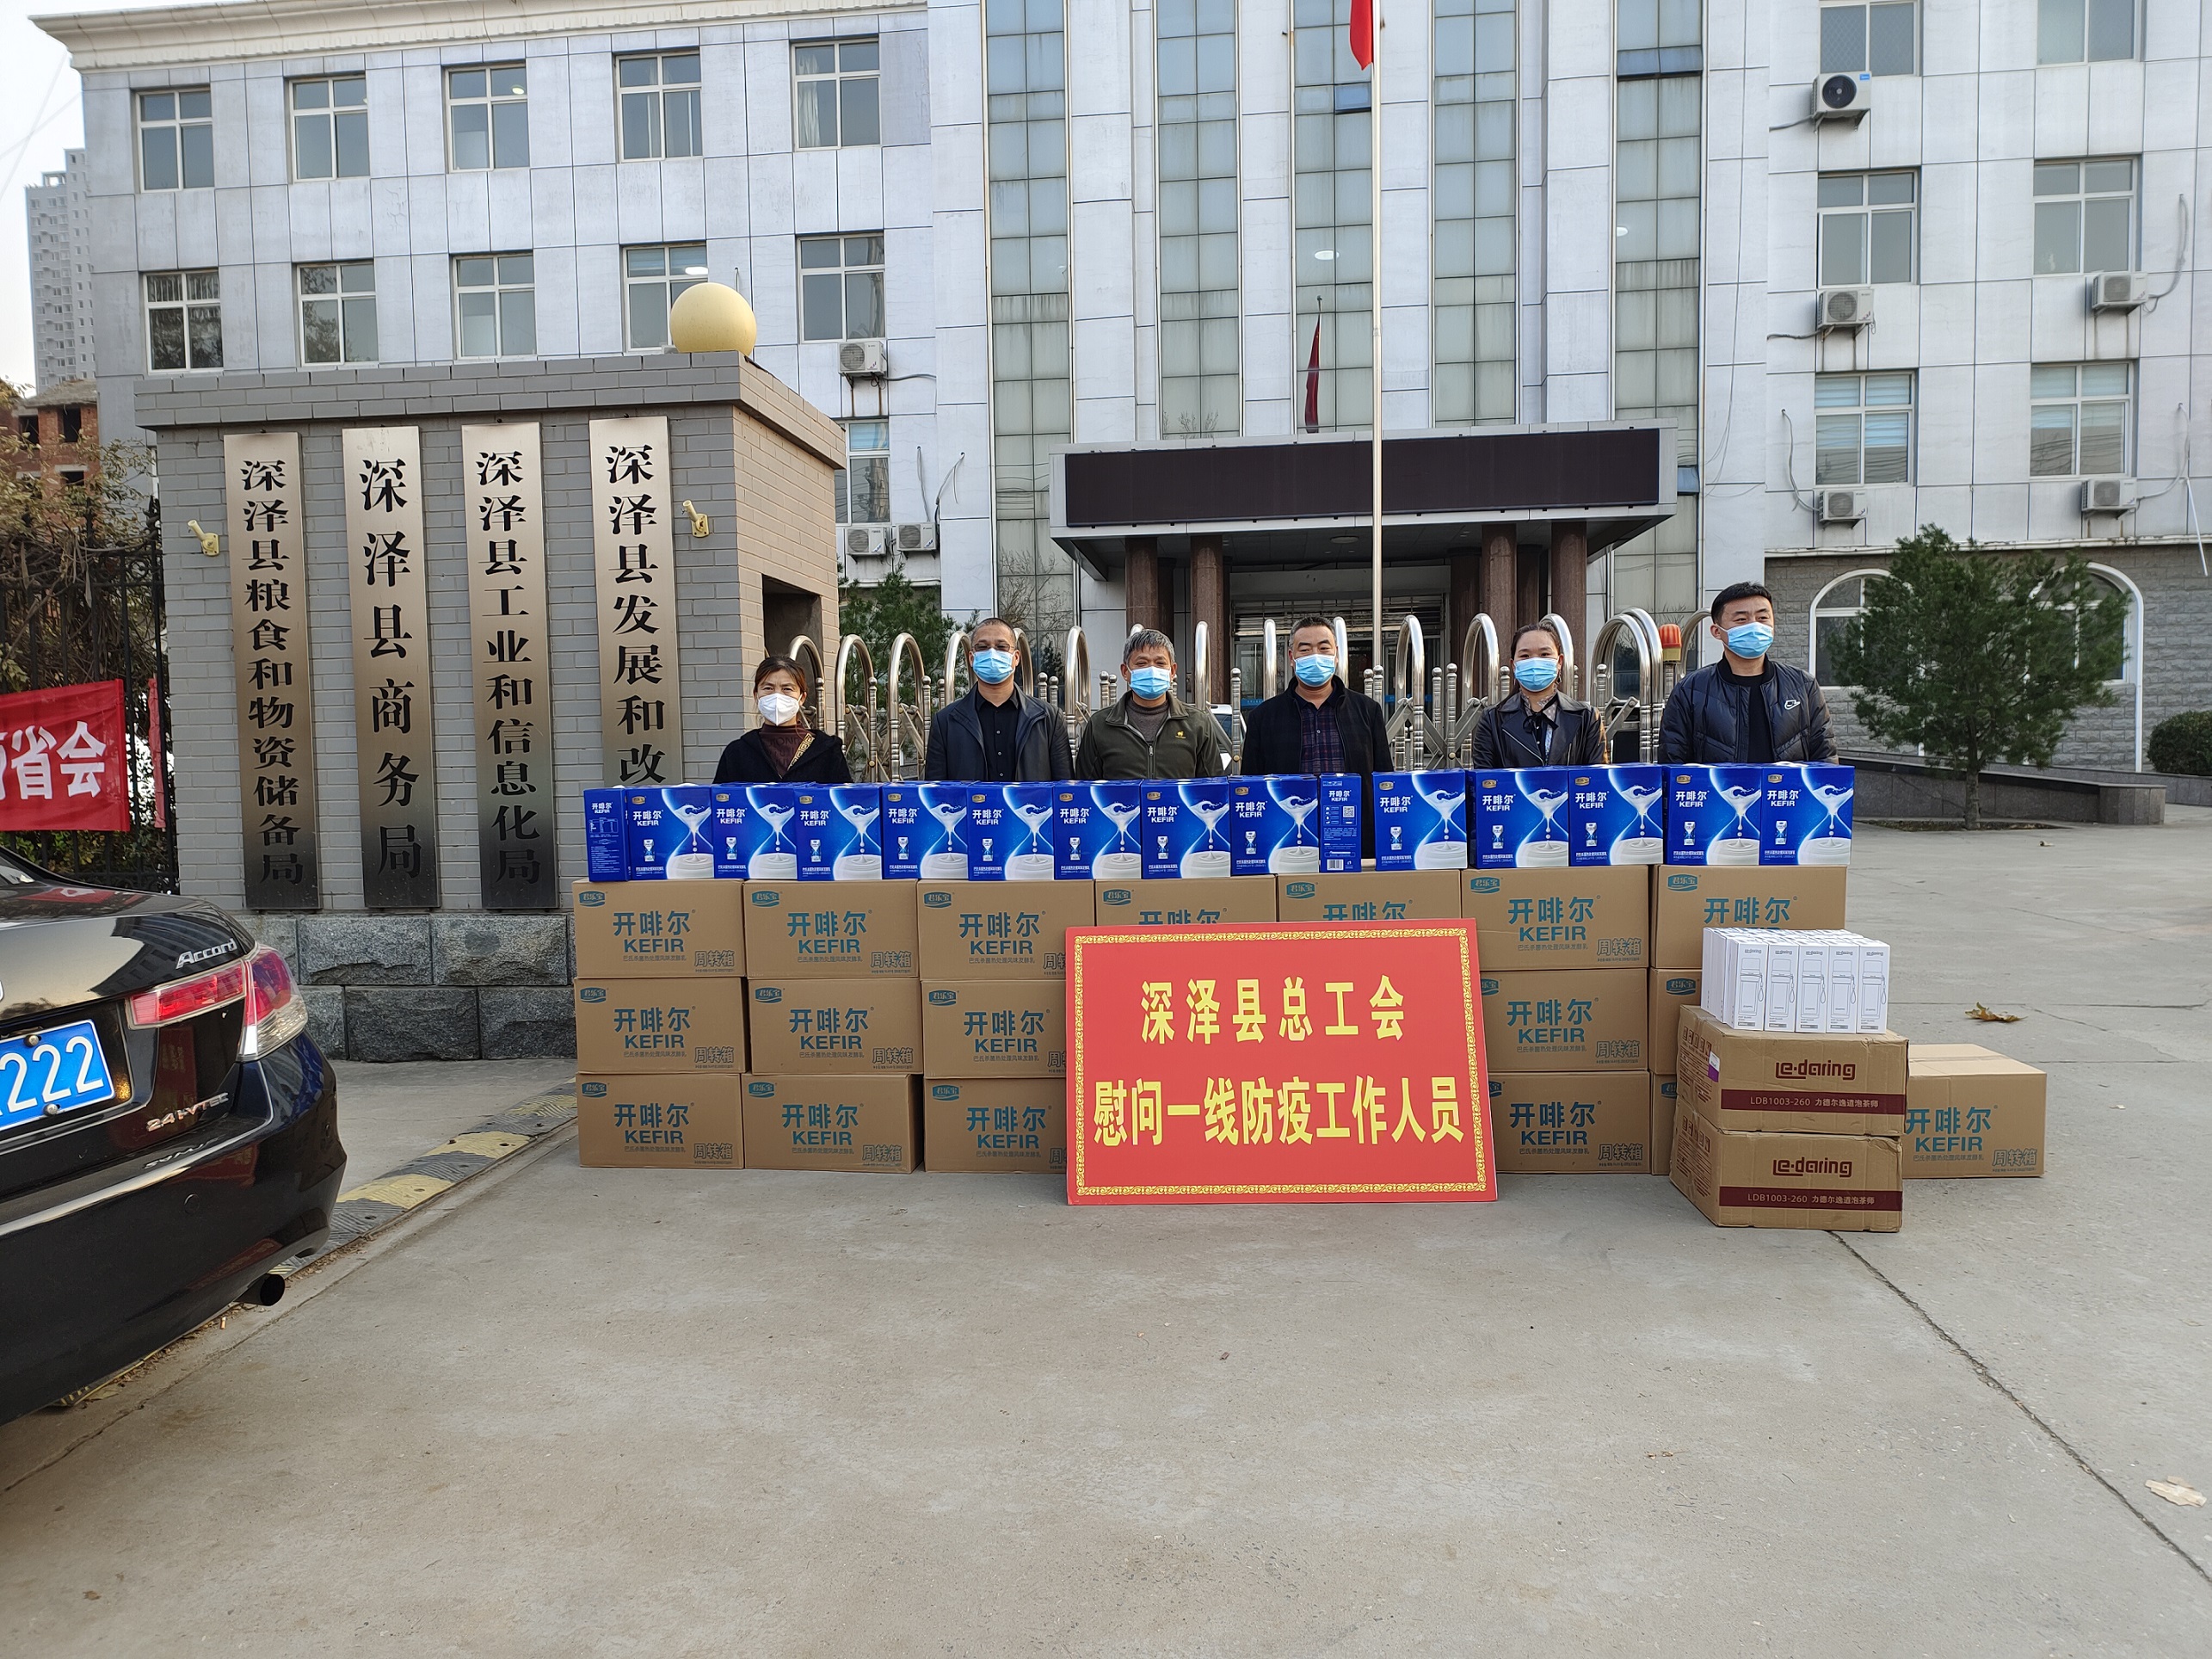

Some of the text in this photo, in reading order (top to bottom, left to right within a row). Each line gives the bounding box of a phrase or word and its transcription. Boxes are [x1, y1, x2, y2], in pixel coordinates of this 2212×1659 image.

[605, 443, 666, 784] 深泽县发展和改
[240, 459, 304, 888] 深泽县粮食和物资储备局
[359, 457, 422, 879] 深泽县商务局
[476, 450, 541, 887] 深泽县工业和信息化局
[0, 720, 107, 800] 省会
[1380, 796, 1411, 807] 开啡尔
[1482, 795, 1514, 805] 开啡尔
[1574, 792, 1607, 803] 开啡尔
[1676, 791, 1707, 801] 开啡尔
[1767, 790, 1798, 800] 开啡尔
[716, 808, 745, 817] 开啡尔
[888, 808, 917, 817] 开啡尔
[972, 809, 1001, 819] 开啡尔
[1060, 808, 1089, 817] 开啡尔
[1147, 806, 1177, 817] 开啡尔
[1235, 801, 1266, 812] 开啡尔
[633, 811, 662, 820] 开啡尔
[800, 811, 829, 820] 开啡尔
[1323, 902, 1406, 921] 开啡尔
[1507, 897, 1594, 924] 开啡尔
[1704, 897, 1791, 924] 开啡尔
[613, 910, 690, 936] 开啡尔
[786, 911, 867, 937] 开啡尔
[958, 912, 1039, 938] 开啡尔
[1519, 926, 1587, 941] KEFIR
[176, 938, 237, 970] Accord
[624, 938, 684, 953] KEFIR
[798, 940, 860, 953] KEFIR
[970, 941, 1032, 955] KEFIR
[1597, 938, 1642, 956] 周转箱
[694, 950, 735, 967] 周转箱
[871, 951, 912, 967] 周转箱
[1141, 974, 1405, 1045] 深泽县总工会
[1507, 999, 1593, 1027] 开啡尔
[613, 1007, 690, 1033] 开啡尔
[789, 1008, 869, 1033] 开啡尔
[964, 1010, 1044, 1036] 开啡尔
[625, 1034, 685, 1049] KEFIR
[800, 1036, 862, 1050] KEFIR
[1518, 1027, 1585, 1044] KEFIR
[975, 1038, 1038, 1053] KEFIR
[1596, 1040, 1640, 1058] 周转箱
[695, 1046, 734, 1064] 周转箱
[872, 1047, 913, 1064] 周转箱
[0, 1036, 104, 1116] 222
[1750, 1097, 1810, 1106] LDB1003-260
[614, 1103, 690, 1128] 开啡尔
[781, 1103, 859, 1129] 开啡尔
[966, 1107, 1046, 1132] 开啡尔
[1094, 1076, 1465, 1147] 慰问一线防疫工作人员
[1509, 1101, 1596, 1129] 开啡尔
[1906, 1107, 1991, 1134] 开啡尔
[625, 1131, 683, 1144] KEFIR
[792, 1131, 852, 1146] KEFIR
[977, 1134, 1039, 1149] KEFIR
[1521, 1131, 1588, 1145] KEFIR
[1915, 1137, 1982, 1152] KEFIR
[693, 1143, 732, 1159] 周转箱
[862, 1144, 902, 1162] 周转箱
[1599, 1143, 1643, 1161] 周转箱
[1993, 1148, 2037, 1167] 周转箱
[1747, 1193, 1808, 1203] LDB1003-260
